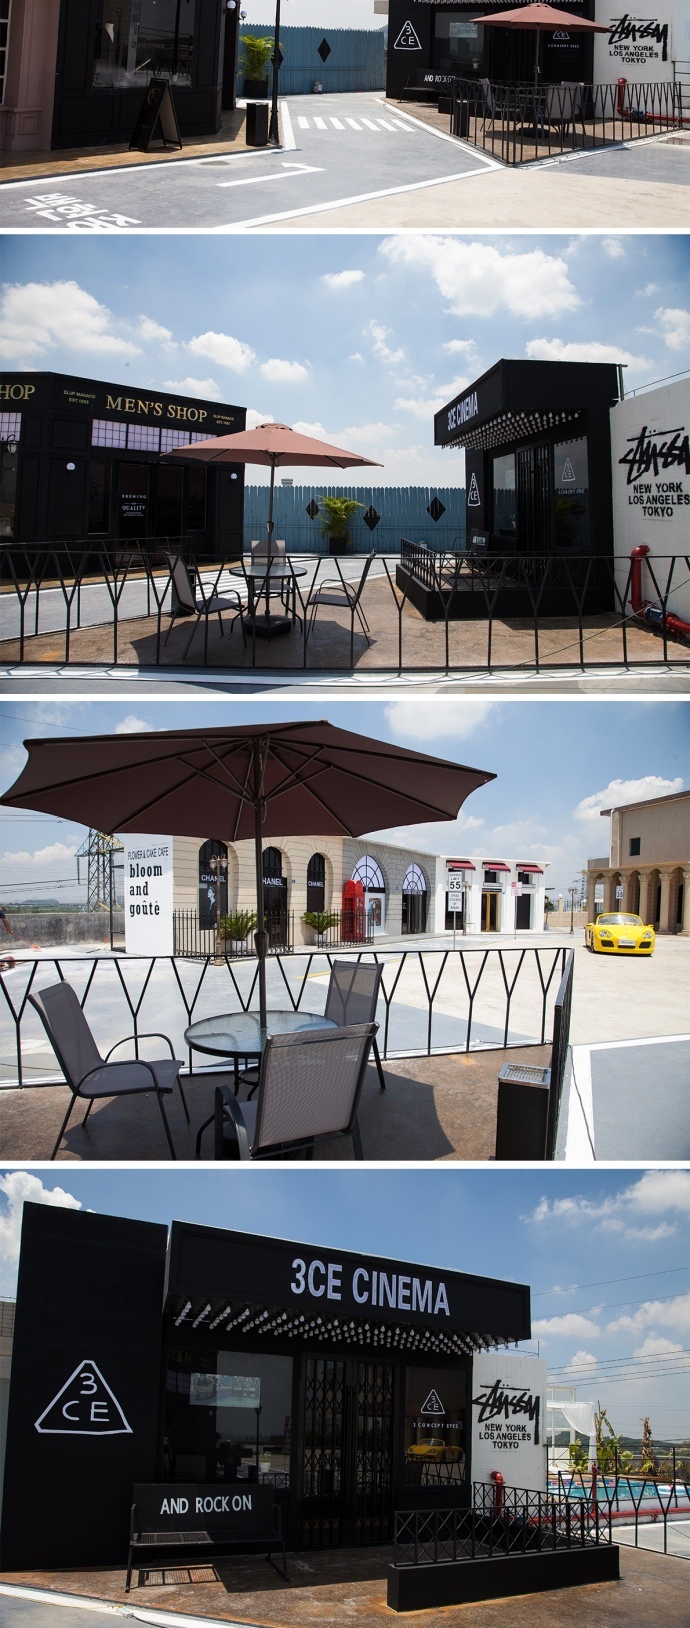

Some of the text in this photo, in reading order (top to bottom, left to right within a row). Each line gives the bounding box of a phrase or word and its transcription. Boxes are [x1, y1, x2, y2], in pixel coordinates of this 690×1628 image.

[106, 394, 207, 422] MEN'S SHOP
[456, 391, 478, 425] CINEMA
[633, 482, 683, 494] NEW YORK
[628, 494, 690, 505] LOS ANGELES
[642, 506, 674, 517] TOKYO
[147, 848, 157, 858] CAKE
[158, 847, 169, 857] CAFE
[129, 863, 163, 878] bloom
[262, 877, 283, 886] HANEL
[308, 880, 324, 888] CHANEL
[450, 881, 461, 889] 55
[129, 881, 149, 896] and
[129, 900, 160, 917] goûté
[290, 1258, 450, 1316] 3CE CINEMA
[505, 1424, 526, 1432] YORK
[492, 1441, 519, 1449] TOKYO
[160, 1495, 252, 1514] AND ROCK ON
